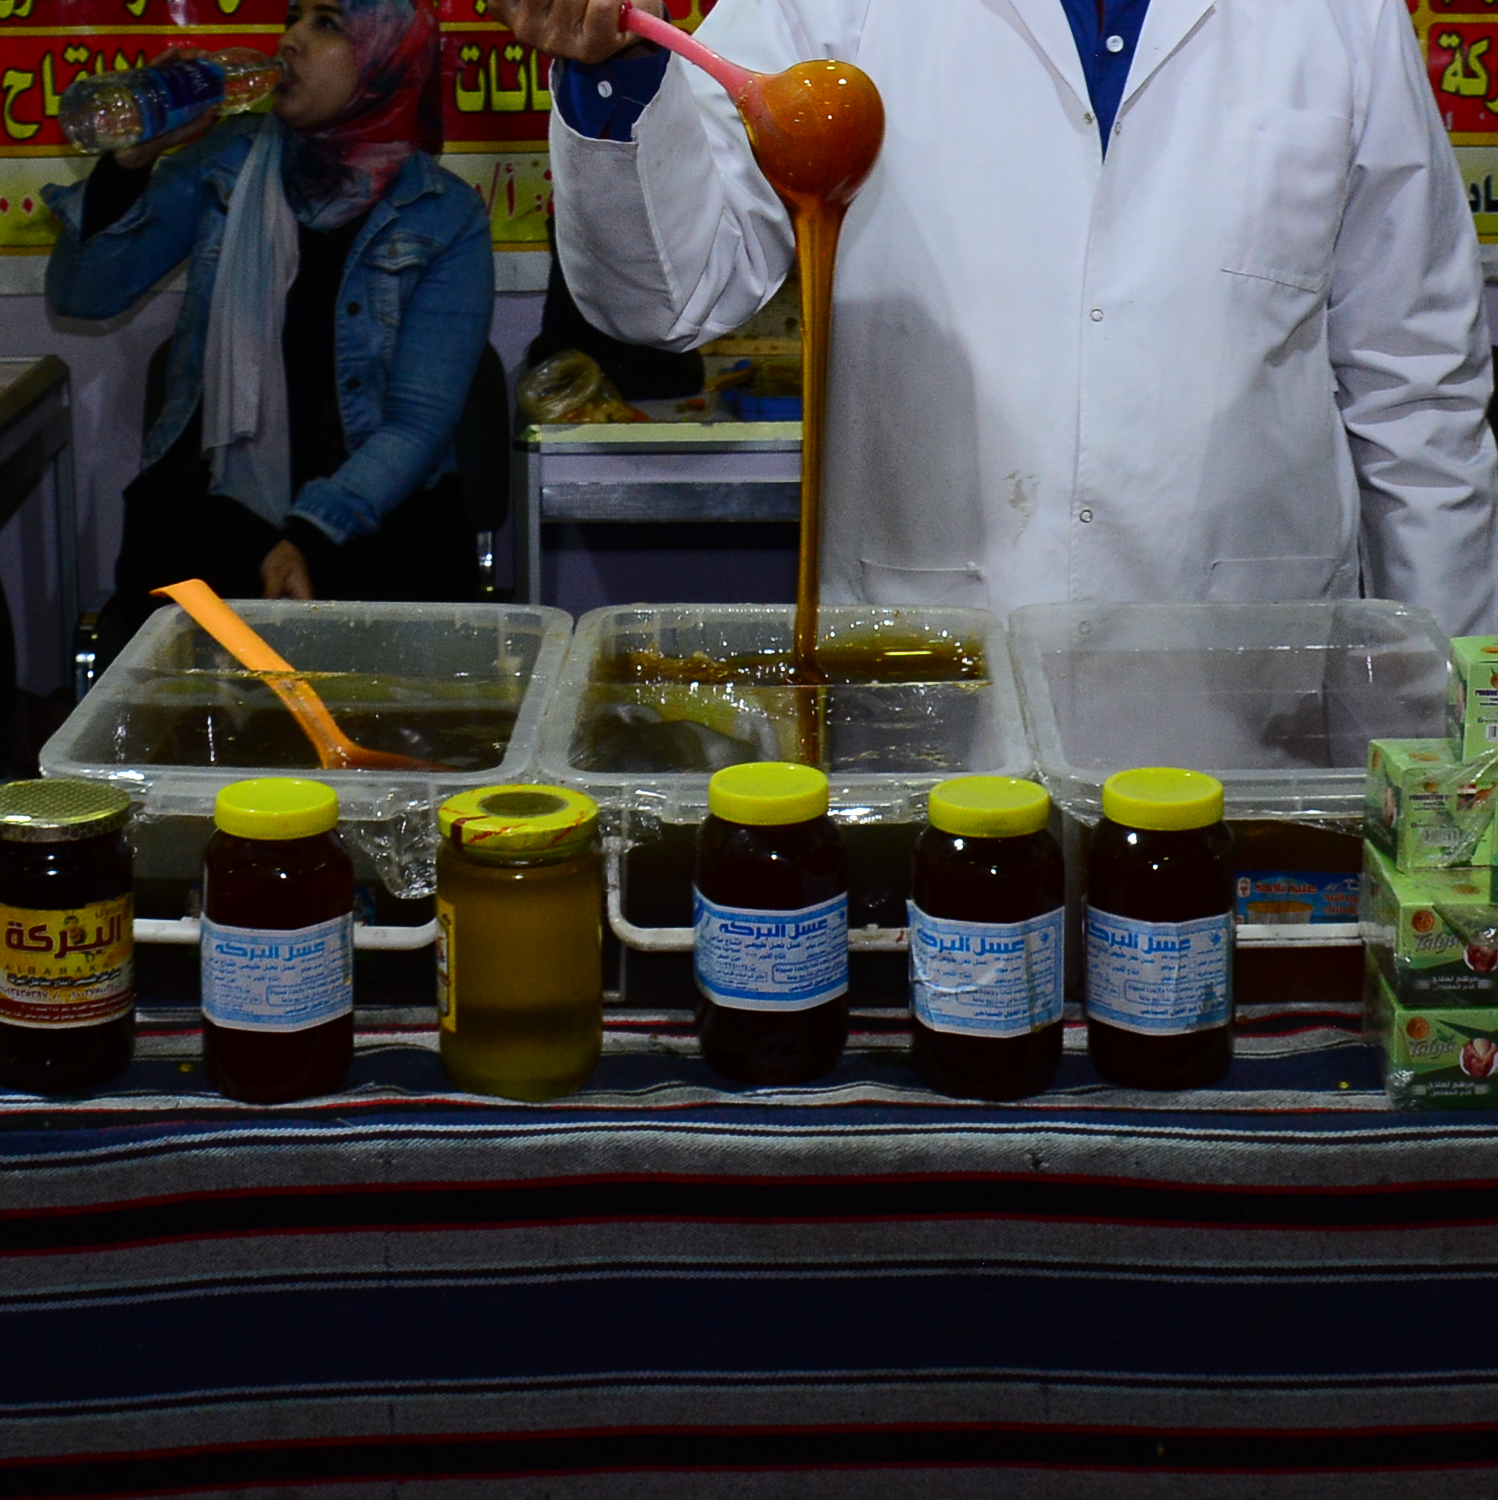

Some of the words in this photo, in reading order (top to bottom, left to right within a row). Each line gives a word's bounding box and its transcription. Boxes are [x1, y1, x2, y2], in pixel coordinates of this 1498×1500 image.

[5, 913, 122, 959] البركة
[787, 918, 828, 940] عسل
[282, 941, 325, 961] عسل
[972, 938, 1025, 956] عسل
[1141, 937, 1191, 954] عسل
[1409, 1038, 1456, 1059] Talya
